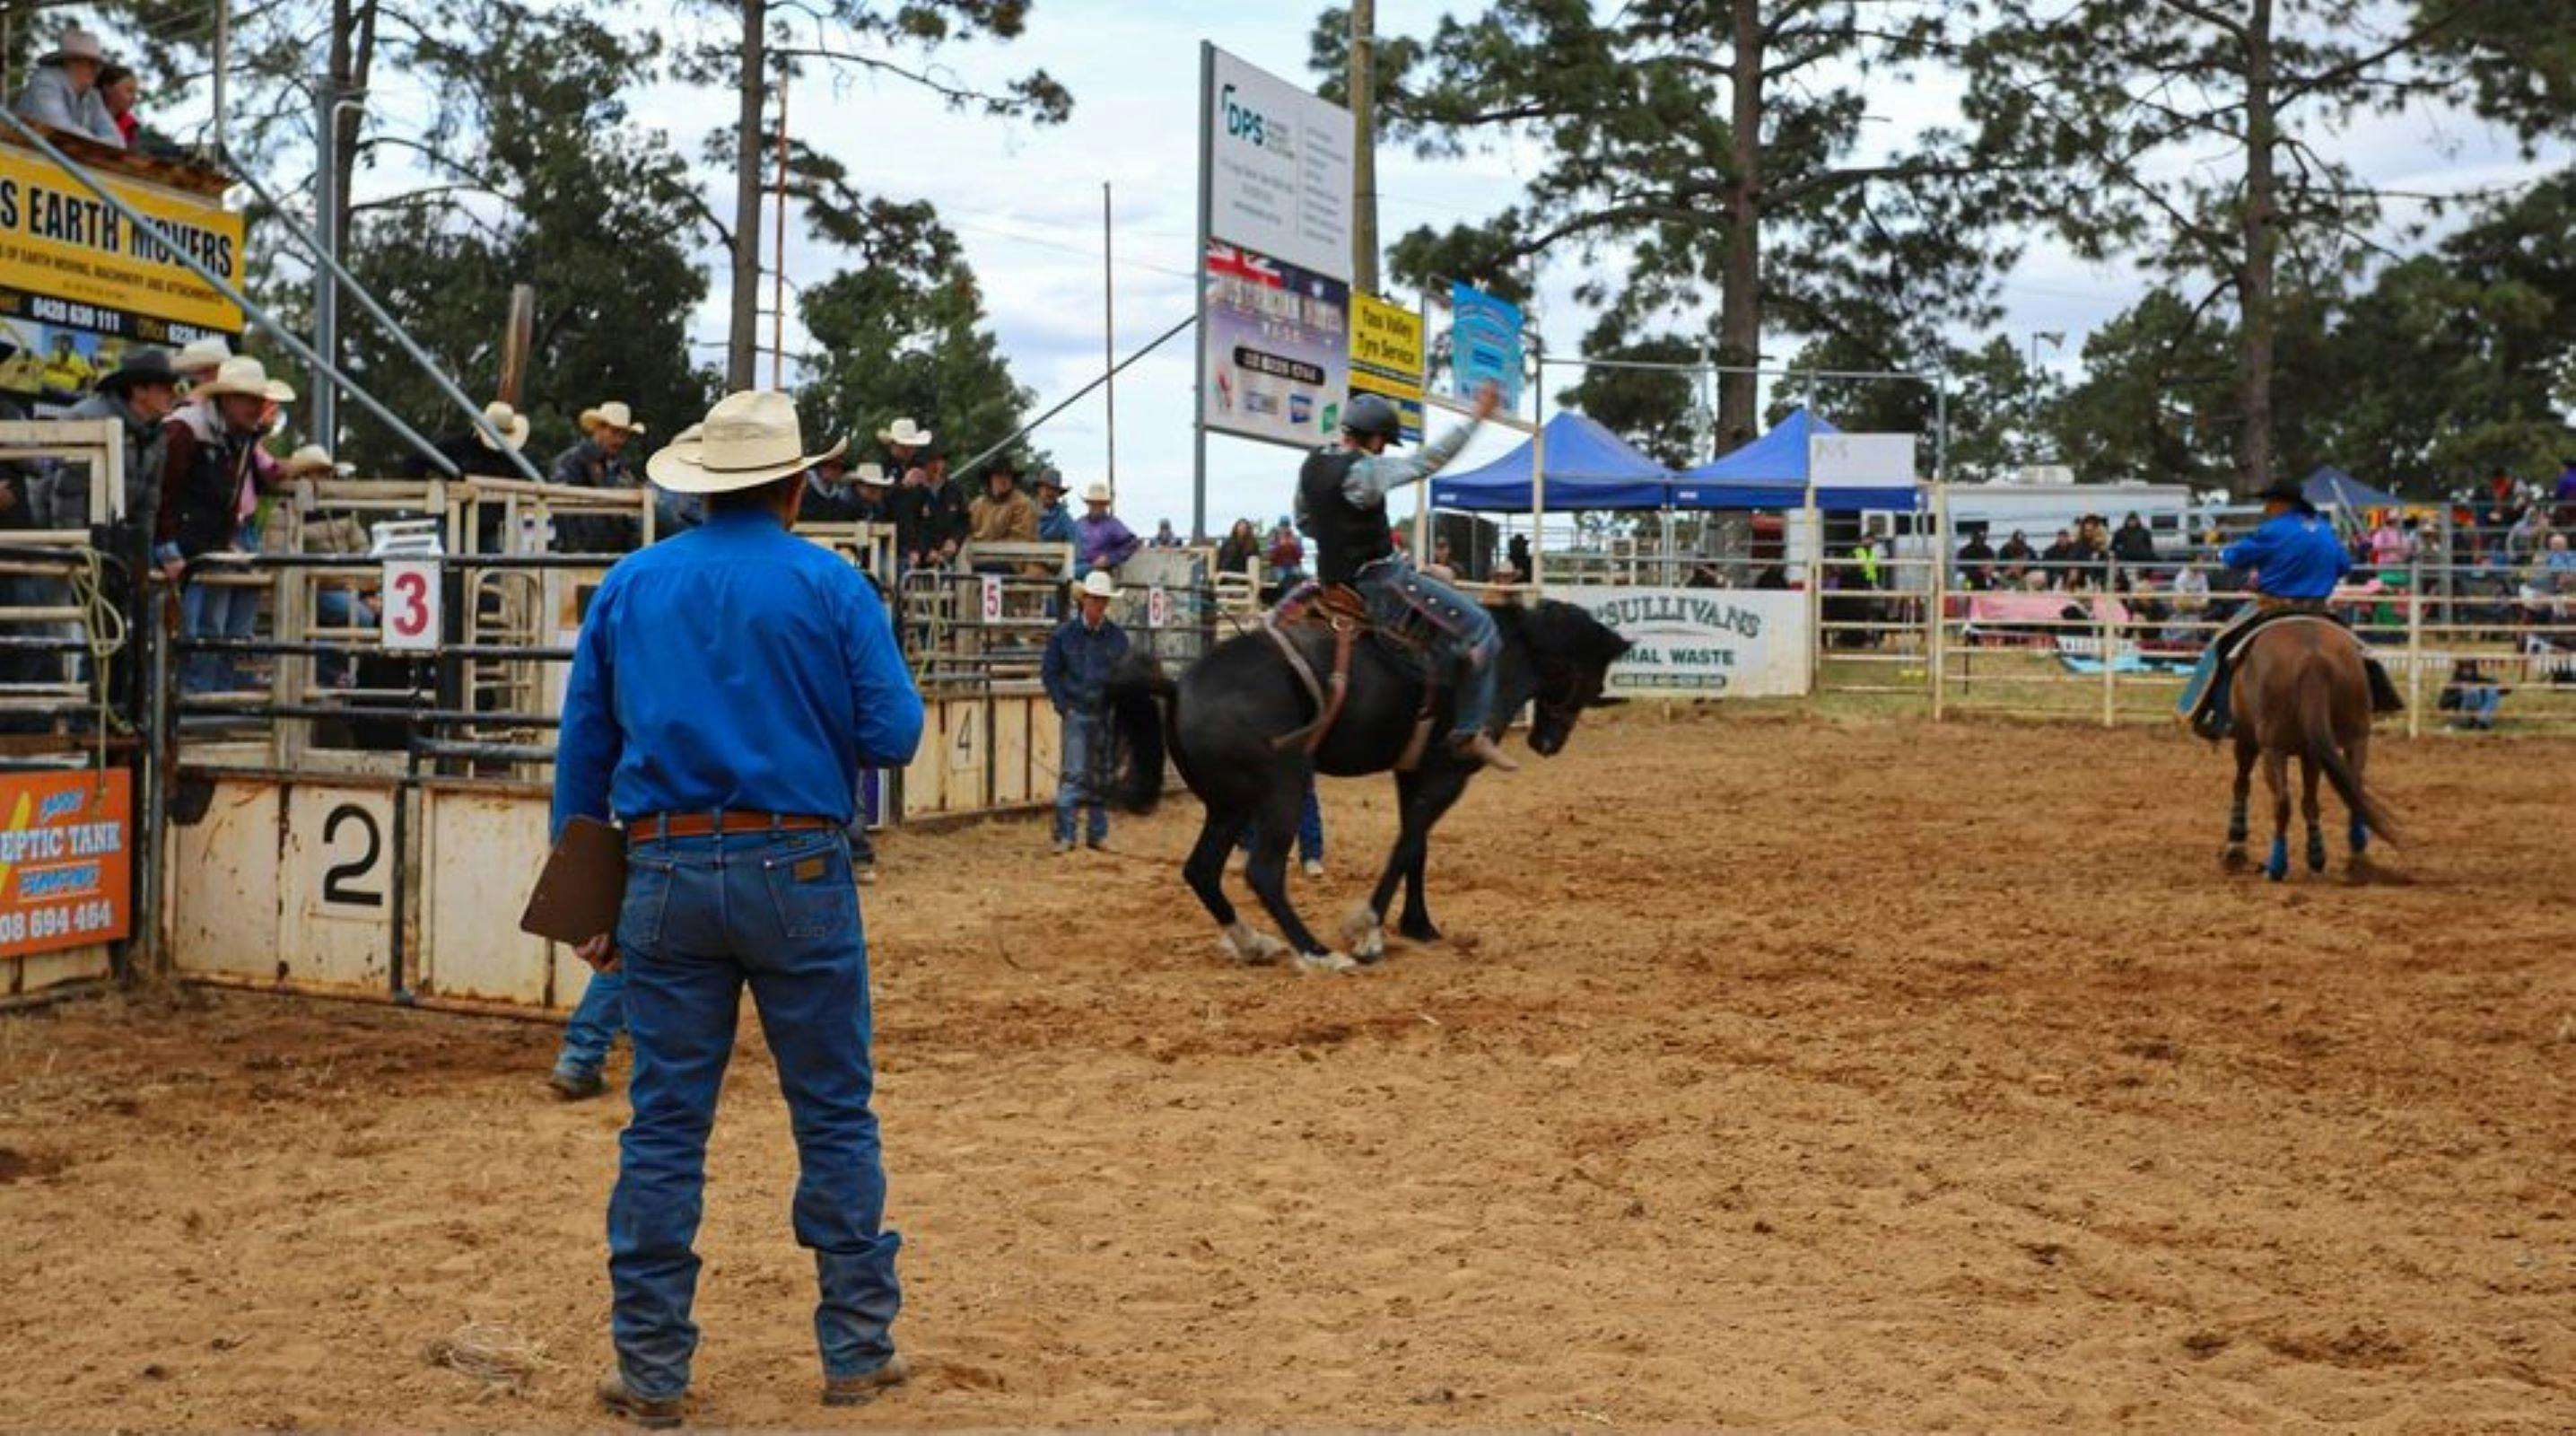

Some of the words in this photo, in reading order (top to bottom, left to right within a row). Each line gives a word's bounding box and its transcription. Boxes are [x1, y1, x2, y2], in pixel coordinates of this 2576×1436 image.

[1227, 102, 1263, 146] DPS
[30, 188, 119, 252] EARTH
[98, 311, 119, 333] 111
[393, 572, 428, 637] 3
[987, 583, 999, 616] 5
[1152, 592, 1161, 621] 6
[1669, 648, 1734, 665] WASTE
[957, 706, 972, 763] 4
[67, 821, 122, 855] TANK
[323, 802, 382, 906] 2
